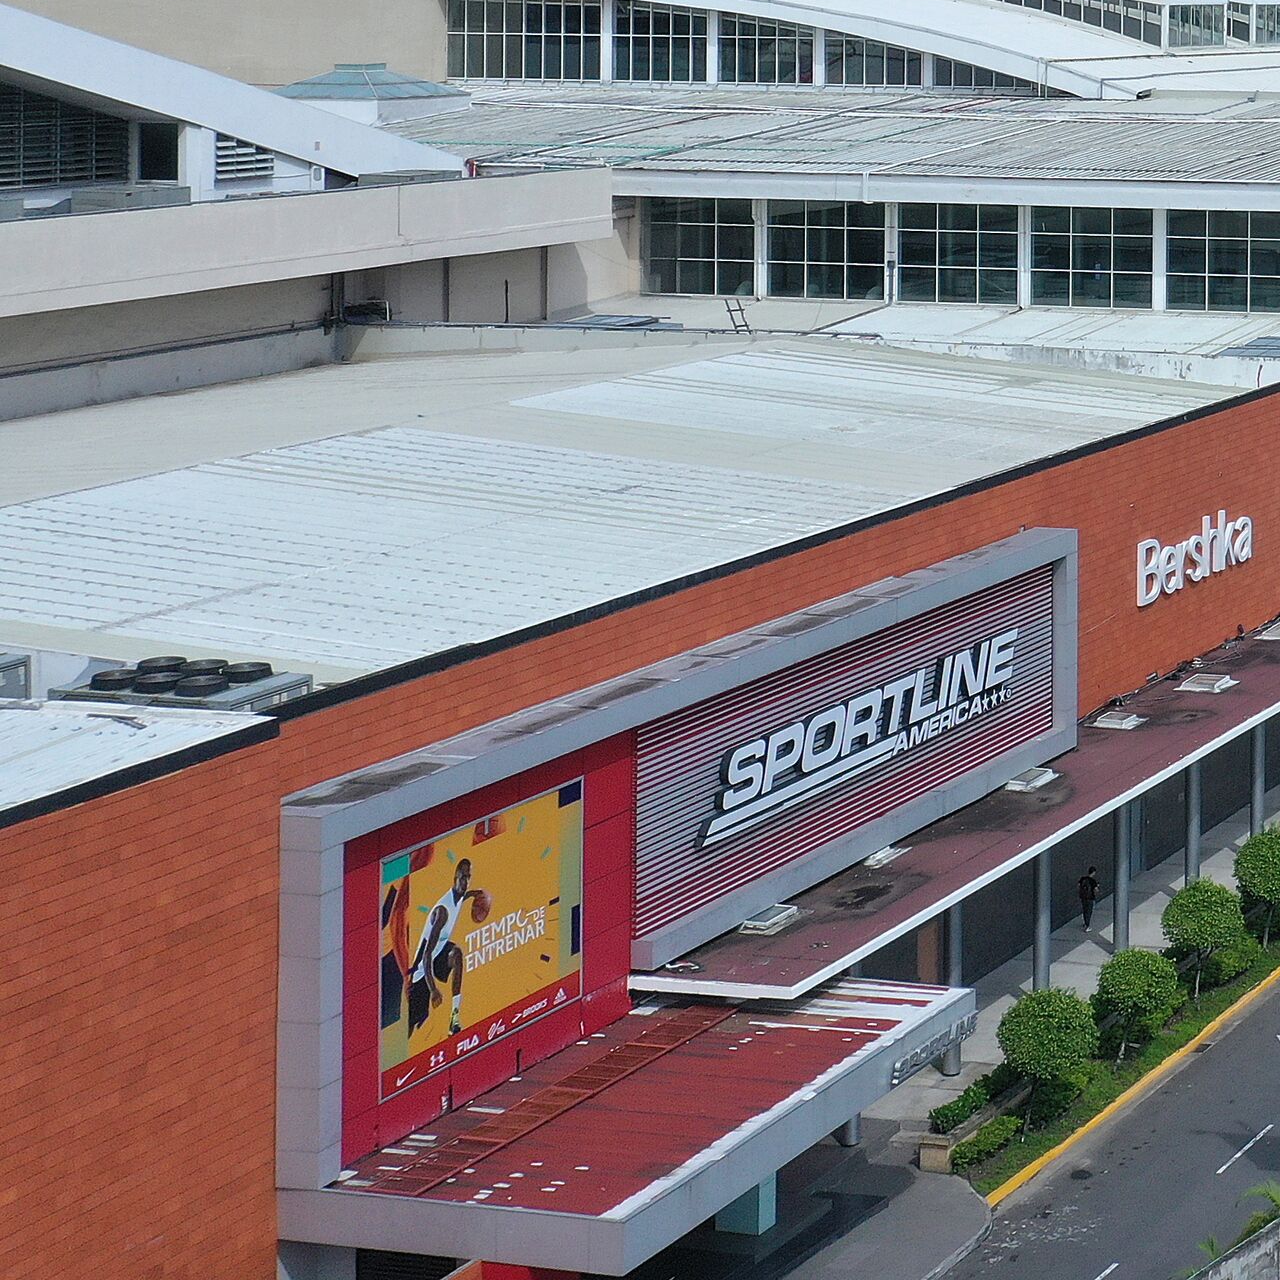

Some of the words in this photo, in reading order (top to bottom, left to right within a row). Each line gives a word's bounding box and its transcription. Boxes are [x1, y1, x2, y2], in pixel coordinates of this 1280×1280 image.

[1137, 510, 1252, 607] Bershka
[718, 628, 1018, 811] SPORTLINE
[893, 695, 982, 756] AMERICA
[465, 909, 531, 952] TIEMPO
[533, 905, 546, 920] DE
[465, 920, 545, 973] ENTRENAR
[457, 1035, 479, 1054] FILA
